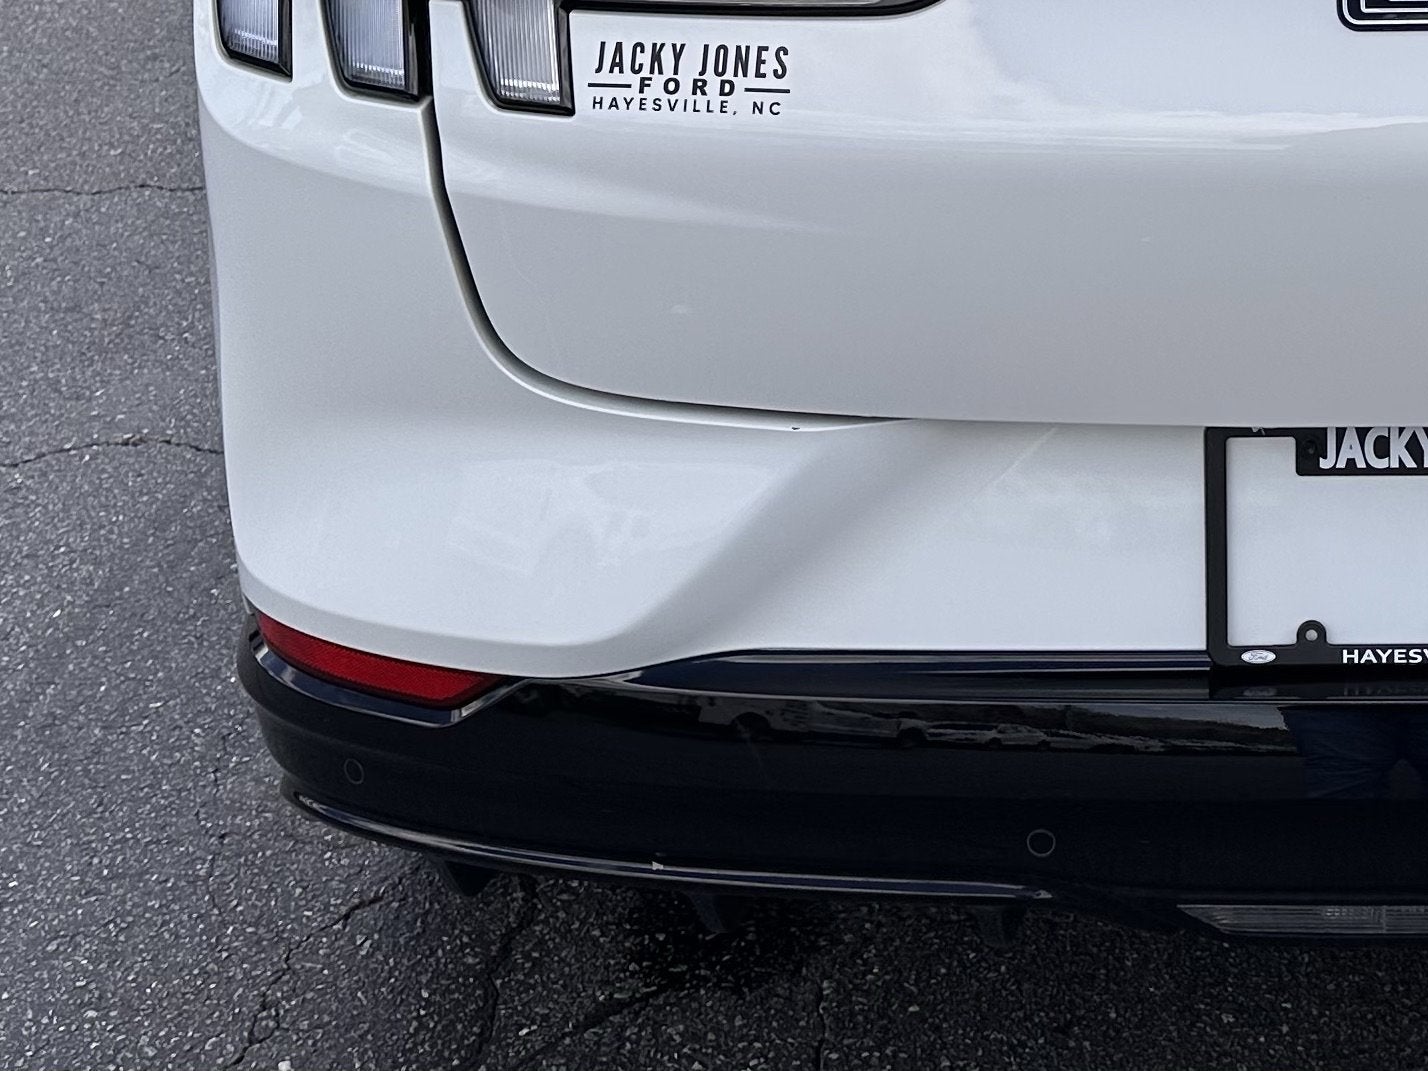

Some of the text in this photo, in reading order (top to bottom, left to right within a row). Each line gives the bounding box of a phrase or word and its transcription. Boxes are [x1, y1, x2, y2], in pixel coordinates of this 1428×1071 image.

[594, 40, 790, 80] JACKY JONES
[638, 76, 736, 97] FORD
[592, 95, 782, 116] HAYESVILLE, NC
